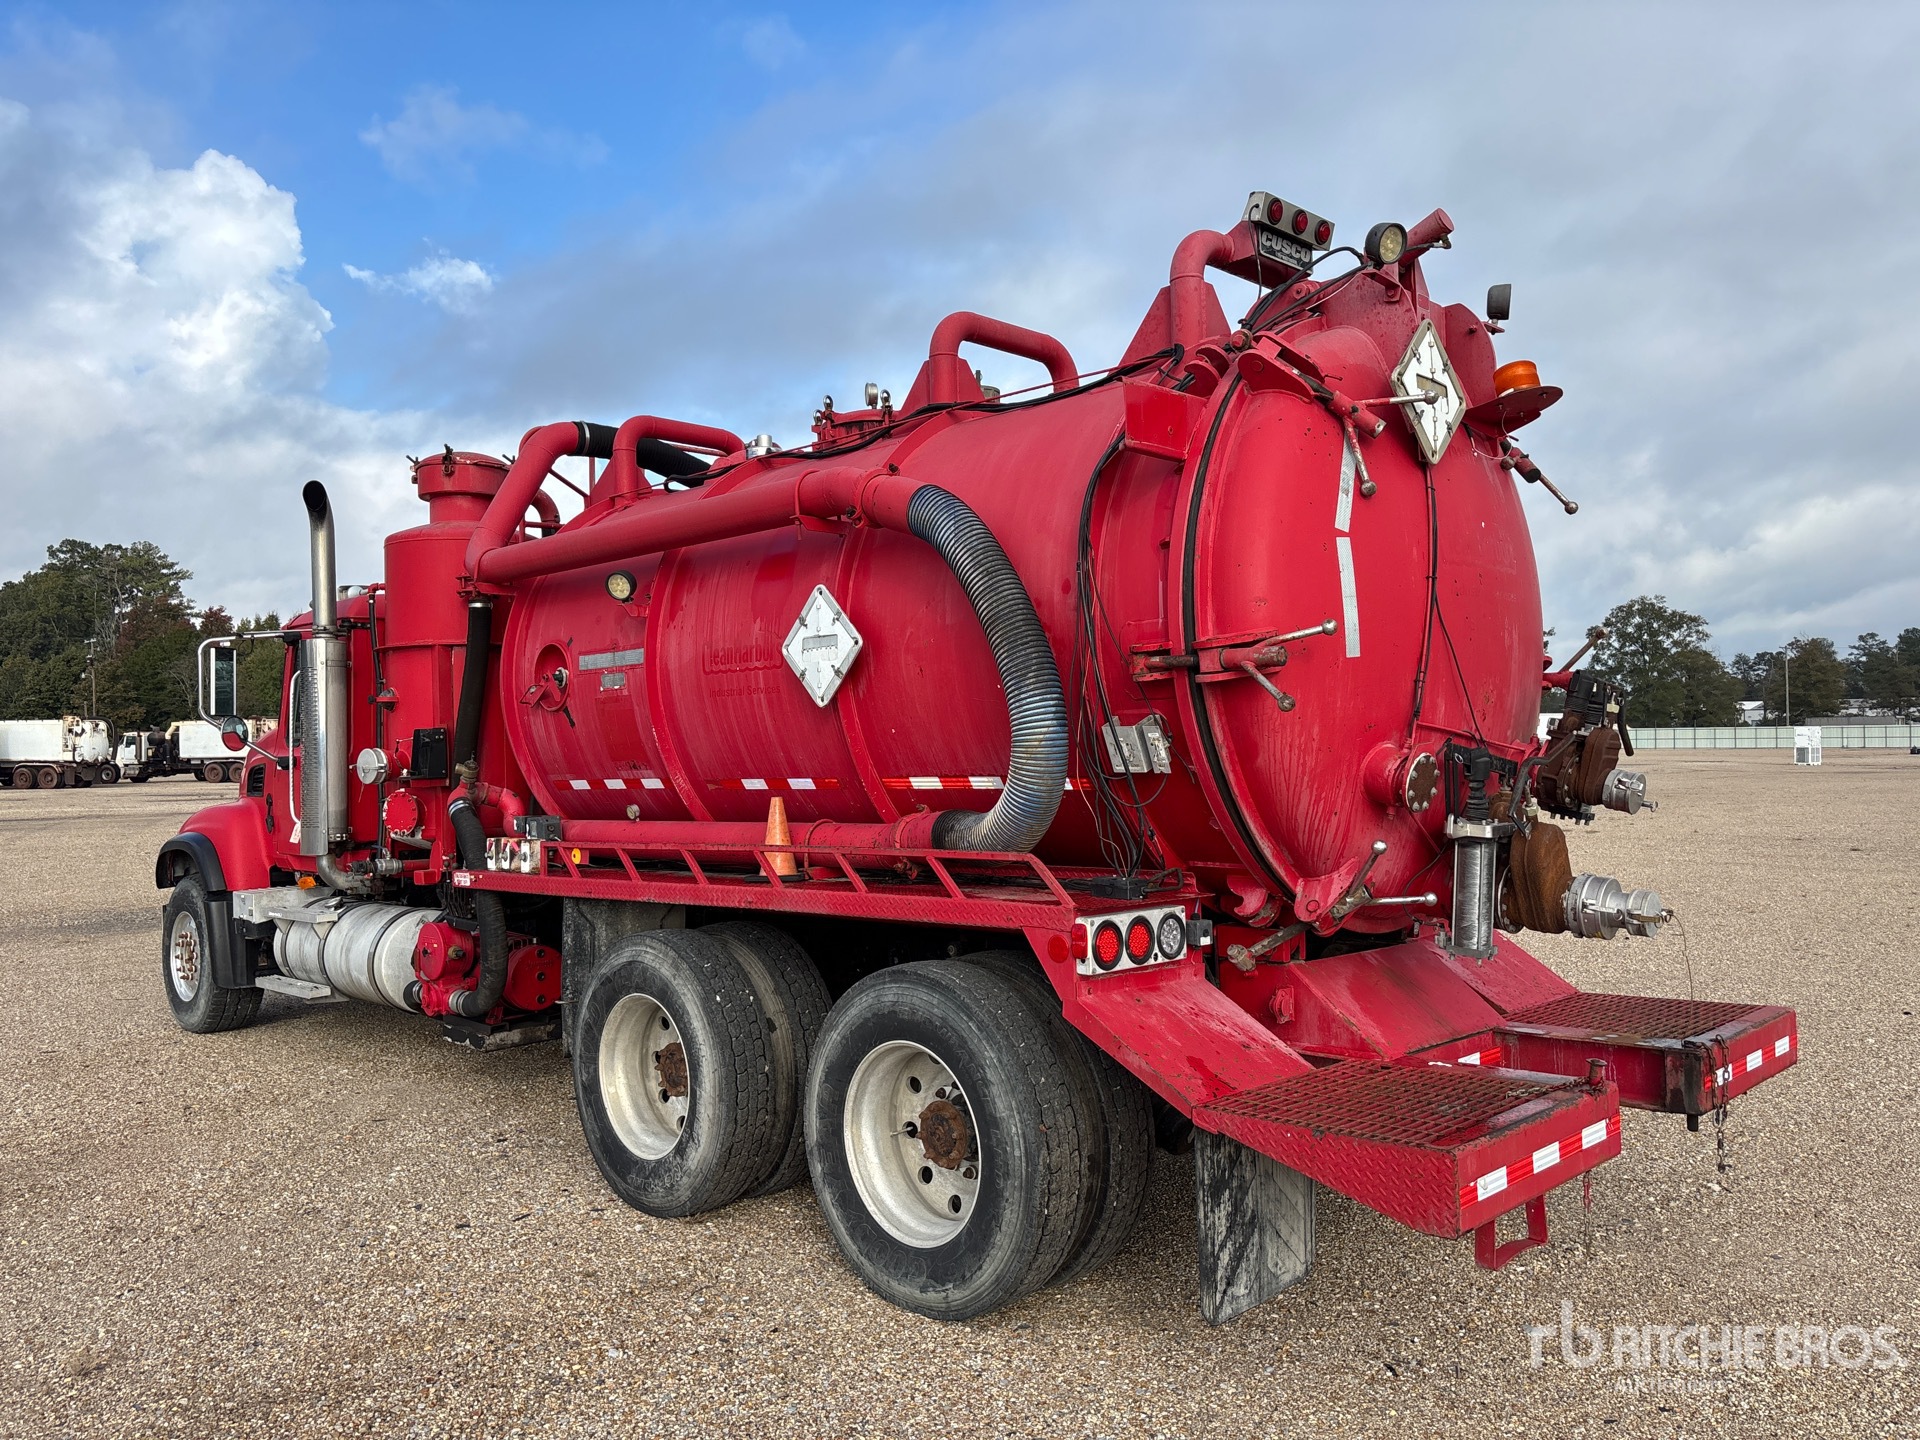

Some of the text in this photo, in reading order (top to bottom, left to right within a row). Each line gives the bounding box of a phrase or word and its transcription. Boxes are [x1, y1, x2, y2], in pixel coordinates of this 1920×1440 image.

[1261, 231, 1311, 263] CUSCO
[710, 685, 780, 698] Industrial Services
